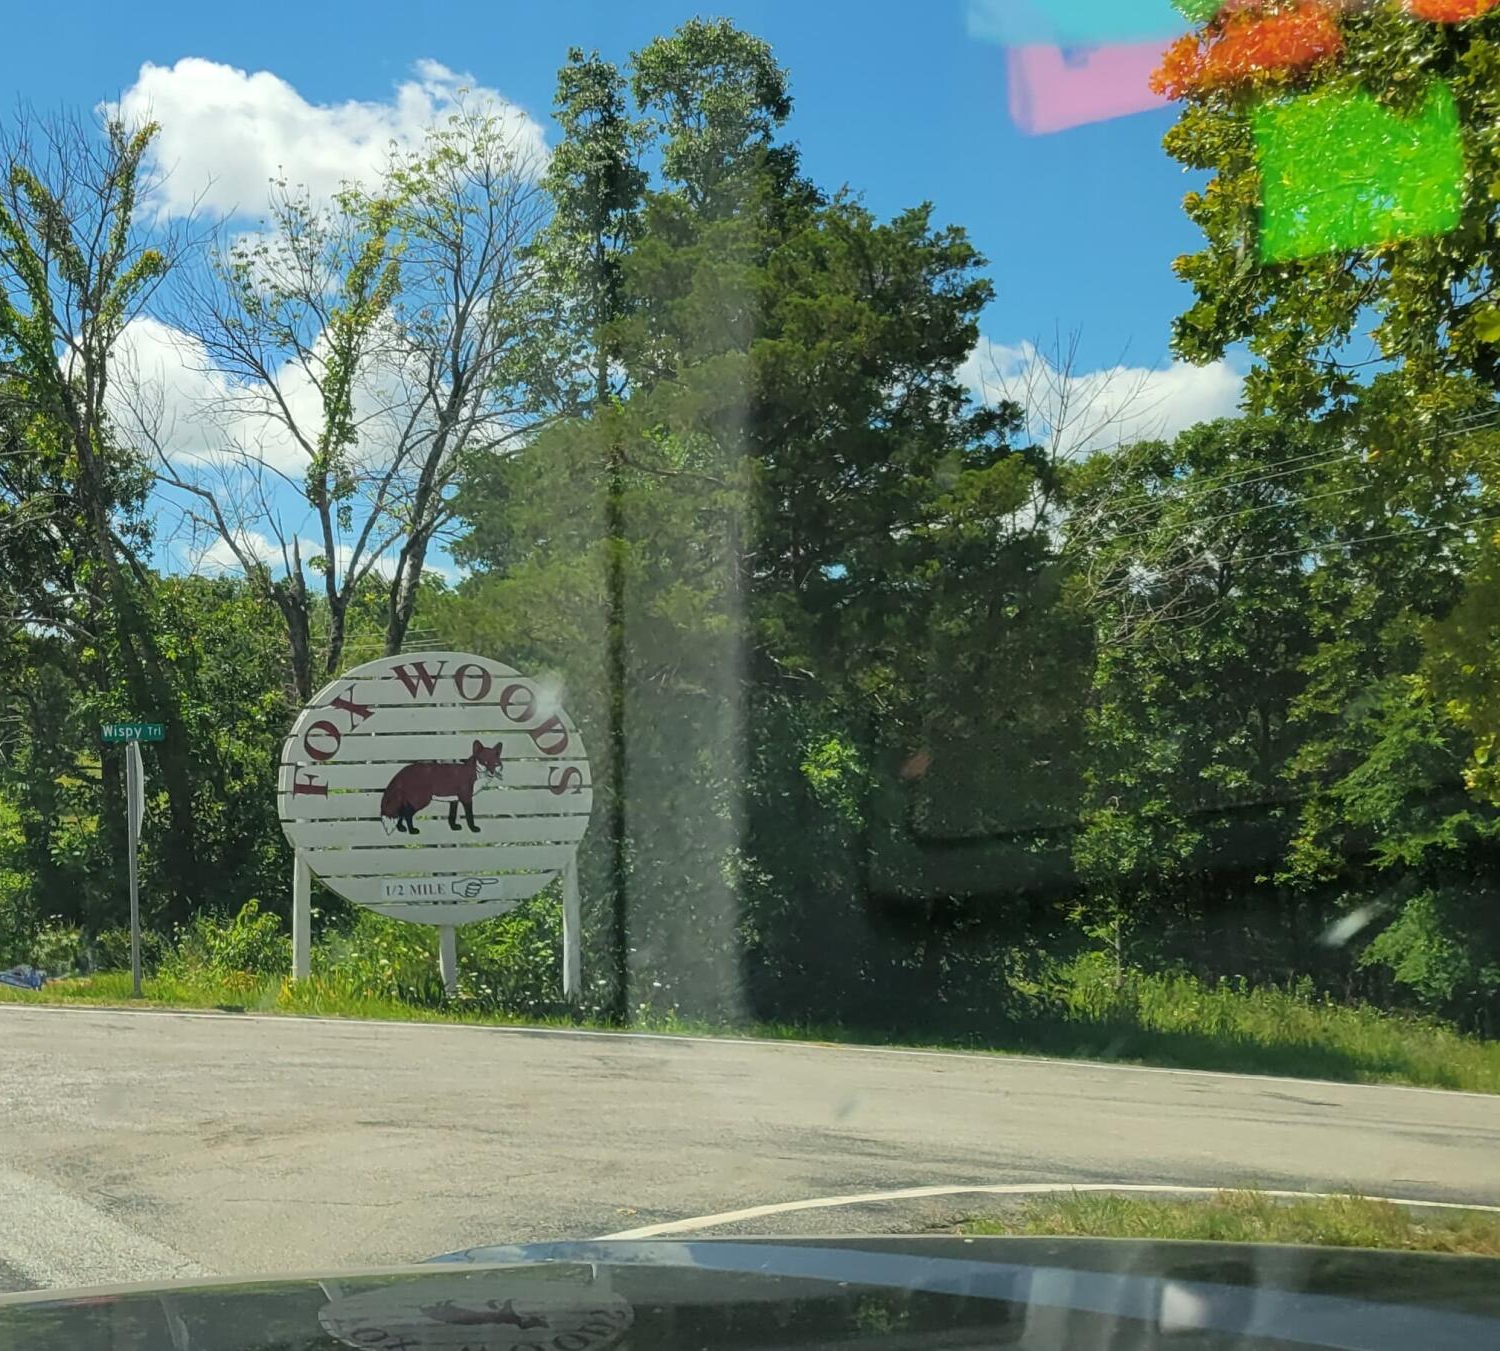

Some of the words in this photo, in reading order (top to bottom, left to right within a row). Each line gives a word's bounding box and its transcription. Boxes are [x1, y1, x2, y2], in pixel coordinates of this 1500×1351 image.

[102, 725, 142, 739] Wispy
[293, 683, 376, 800] FOX
[389, 660, 583, 795] WOODS
[386, 885, 405, 896] 1/2
[410, 884, 447, 896] MILE
